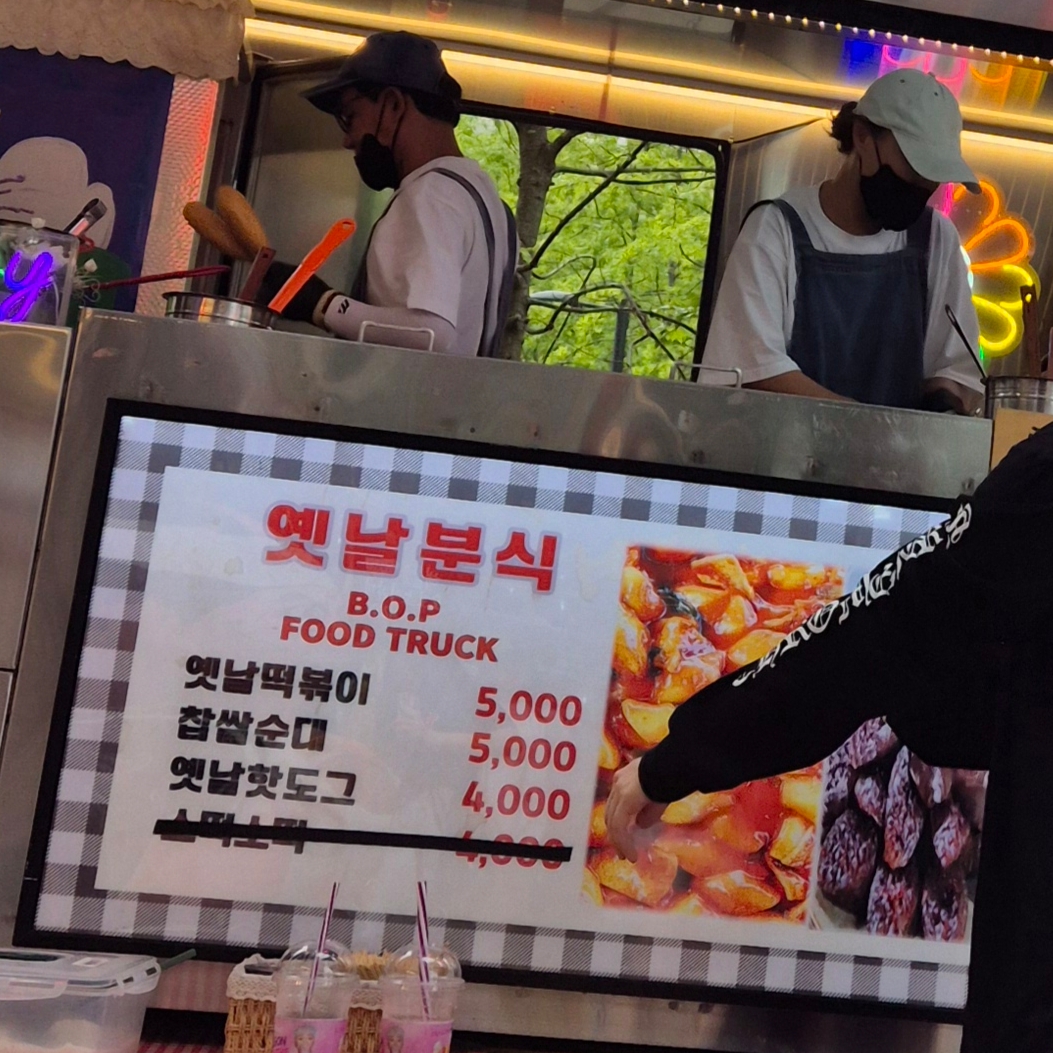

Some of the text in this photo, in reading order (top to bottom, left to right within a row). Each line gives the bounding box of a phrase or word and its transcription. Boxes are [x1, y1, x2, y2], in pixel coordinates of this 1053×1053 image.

[264, 503, 559, 593] 옛날분식
[279, 615, 499, 663] FOOD TRUCK
[346, 591, 441, 624] B.O.P
[184, 654, 583, 727] 옛날떡볶이 5,000
[176, 705, 577, 773] 찹쌀순대 5,000
[168, 756, 571, 821] 옛날핫도그 4,000
